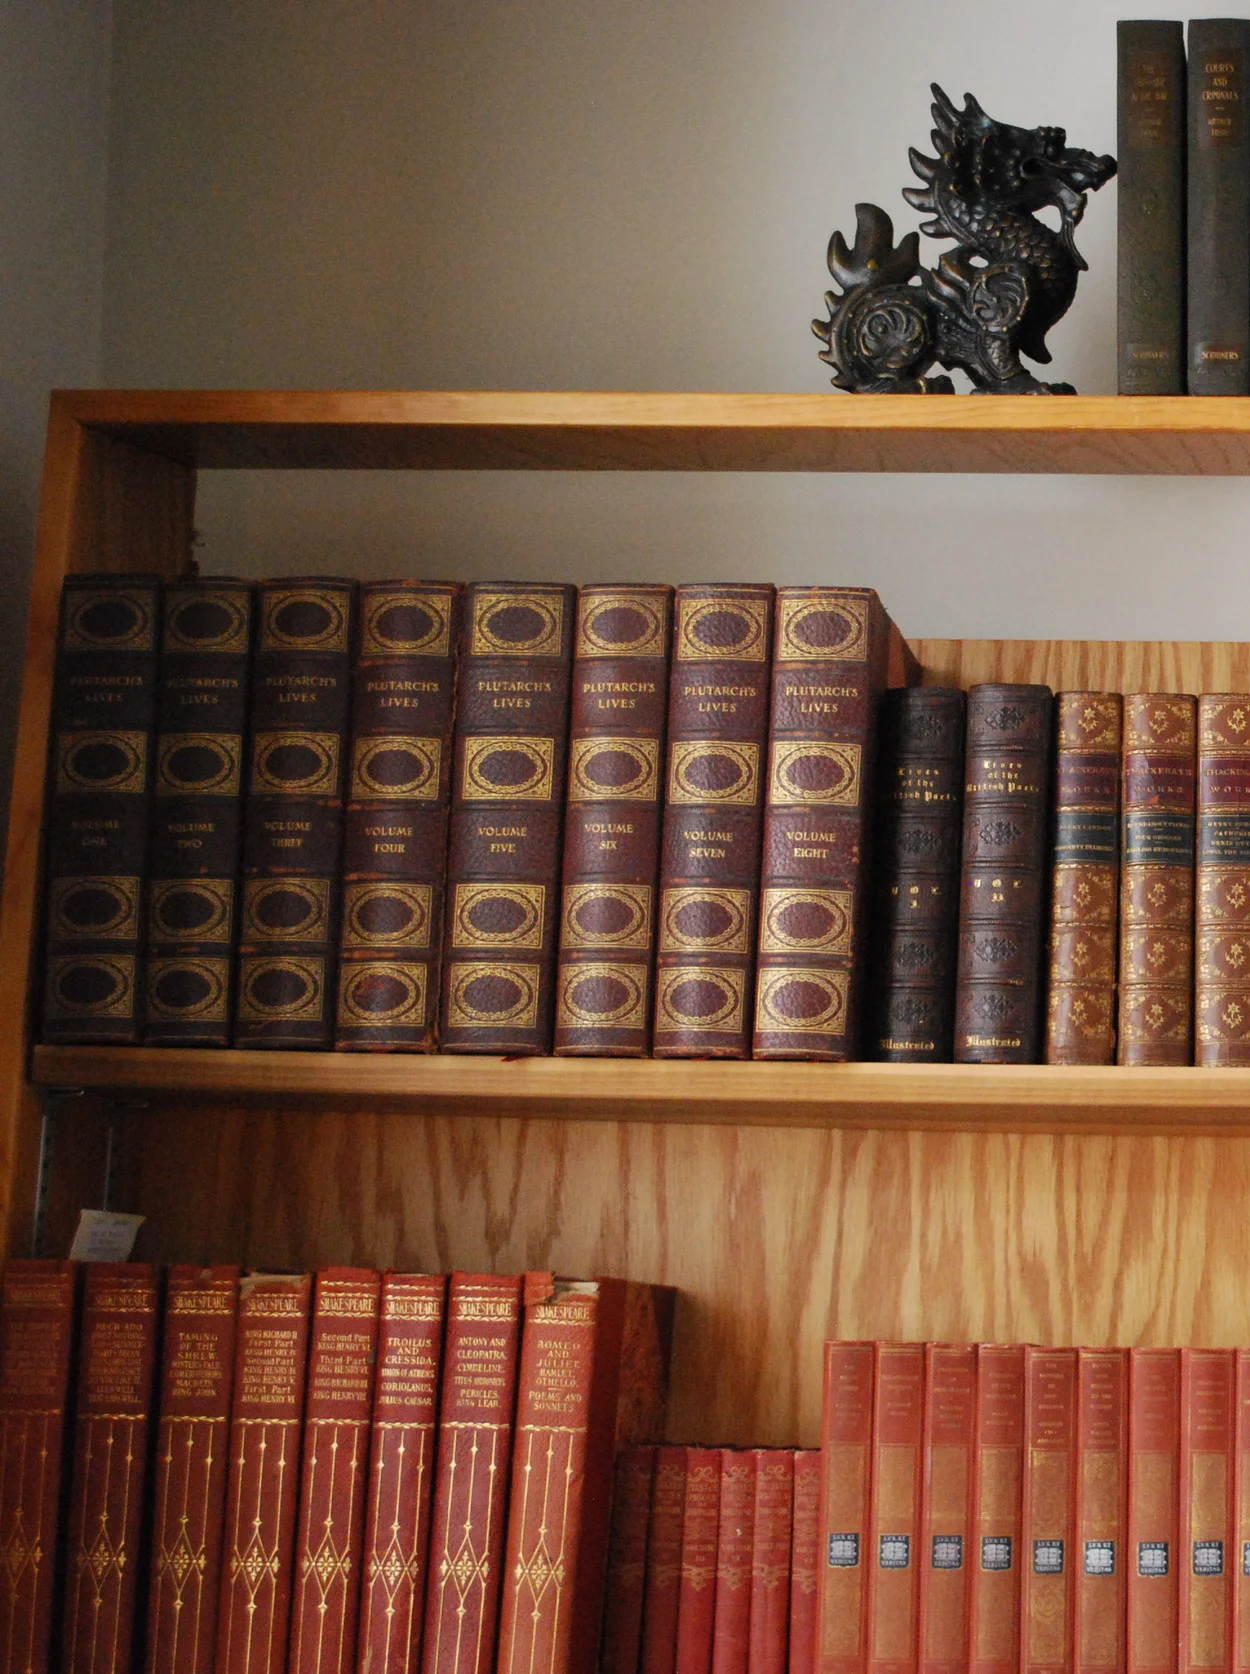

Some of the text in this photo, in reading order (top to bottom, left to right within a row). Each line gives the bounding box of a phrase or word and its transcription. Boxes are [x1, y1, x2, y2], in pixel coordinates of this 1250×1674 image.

[1204, 63, 1234, 73] COURTS
[1212, 77, 1227, 86] AND
[1202, 91, 1238, 100] CRIMINALS
[1202, 351, 1238, 359] SCRIBNERS
[368, 681, 439, 692] PLUTARCH'S
[478, 681, 551, 692] PLUTARCH'S
[583, 683, 655, 693] PLUTARCH'S
[684, 687, 757, 696] PLUTARCH'S
[785, 687, 858, 696] PLUTARCH'S
[181, 695, 218, 704] LIVES
[279, 693, 316, 703] LIVES
[380, 698, 419, 708] LIVES
[493, 699, 531, 708] LIVES
[598, 699, 636, 709] LIVES
[698, 703, 736, 712] LIVES
[800, 703, 838, 712] LIVES
[168, 823, 215, 832] VOLUME
[263, 822, 312, 831] VOLUME
[584, 824, 634, 834] VOLUME
[365, 827, 414, 837] VOLUME
[478, 827, 527, 837] VOLUME
[683, 831, 733, 841] VOLUME
[787, 832, 836, 842] VOLUME
[271, 838, 304, 847] THREE
[600, 840, 617, 850] SIX
[374, 843, 406, 854] FOUR
[490, 844, 516, 853] FIVE
[689, 848, 725, 858] SEVEN
[793, 848, 829, 858] EIGHT
[966, 1035, 1021, 1047] Illustrated
[248, 1299, 298, 1311] SHAKESPEARE
[320, 1298, 374, 1311] SHAKESPEARE
[387, 1302, 439, 1314] SHAKESPEARE
[459, 1303, 511, 1315] SHAKESPEARE
[536, 1306, 589, 1319] SHAKESPEARE
[179, 1332, 218, 1341] TAMING
[322, 1333, 351, 1341] Second
[458, 1337, 506, 1346] ANTONY AND
[388, 1338, 431, 1347] TROILUS
[538, 1340, 580, 1349] ROMEO
[321, 1355, 343, 1364] Third
[457, 1350, 507, 1359] CLEOPATRA.
[385, 1355, 436, 1365] CRESSIDA.
[529, 1391, 581, 1402] POEMS AND
